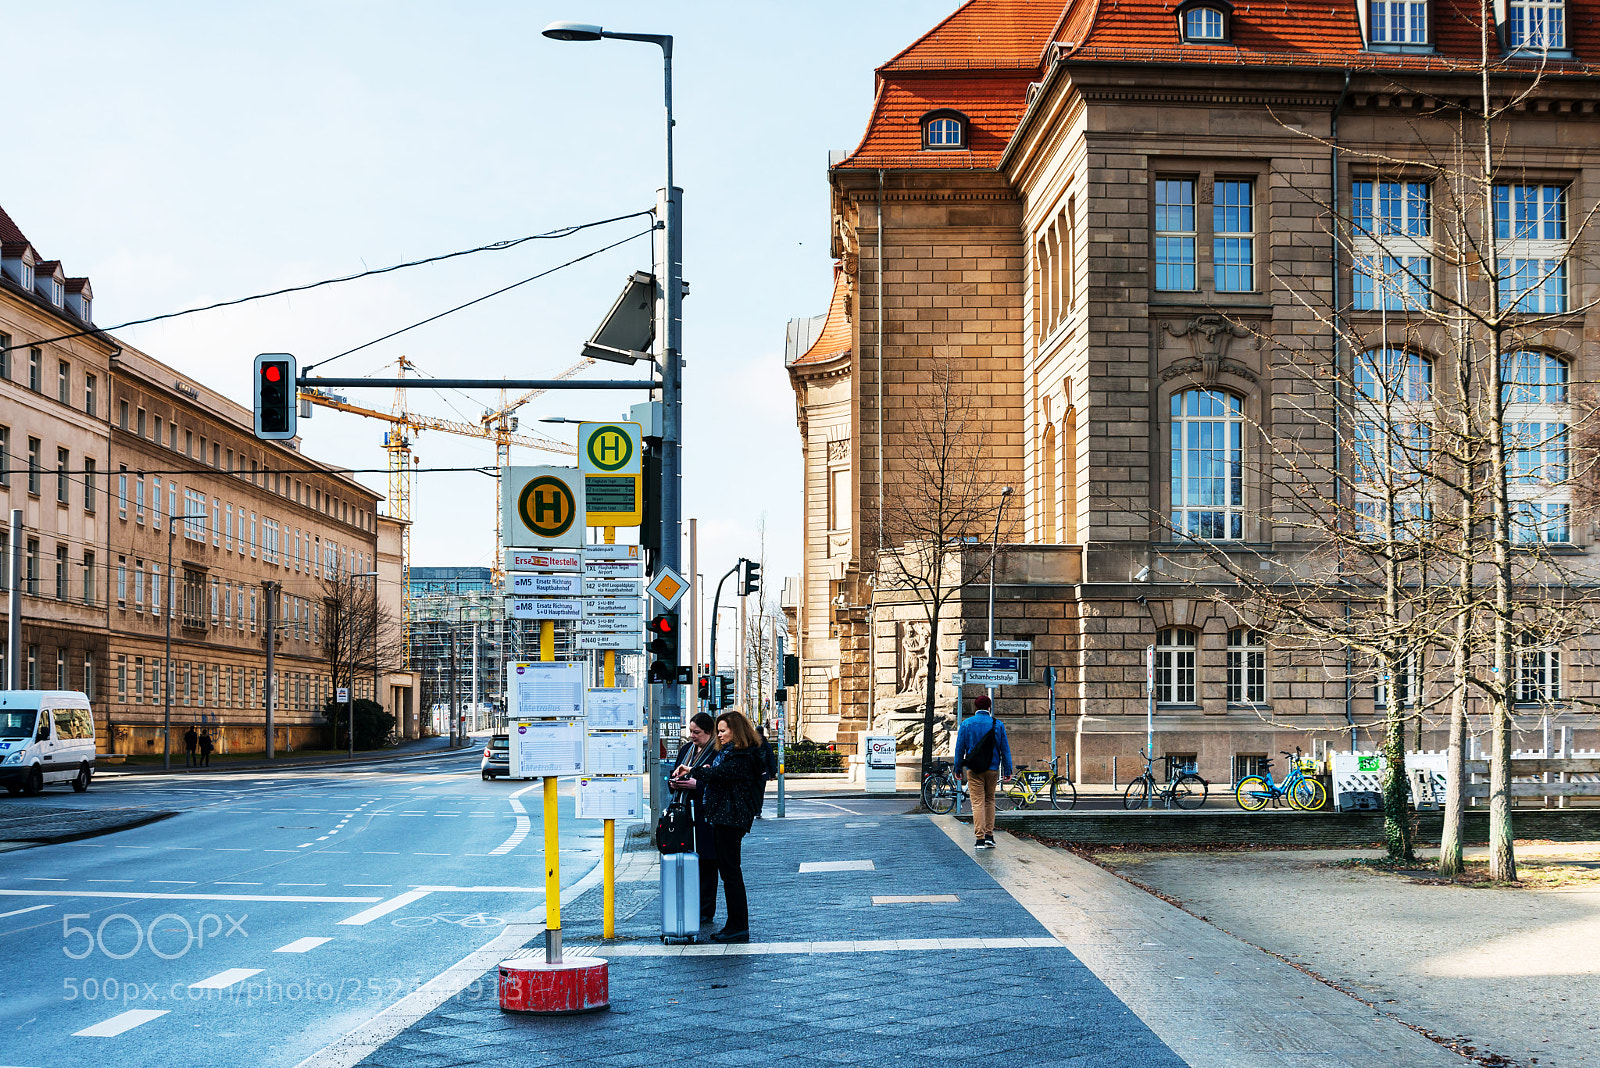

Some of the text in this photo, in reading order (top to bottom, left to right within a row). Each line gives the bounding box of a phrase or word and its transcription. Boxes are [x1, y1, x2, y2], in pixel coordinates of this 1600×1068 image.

[600, 435, 620, 462] H
[534, 490, 562, 524] H
[630, 548, 636, 557] A
